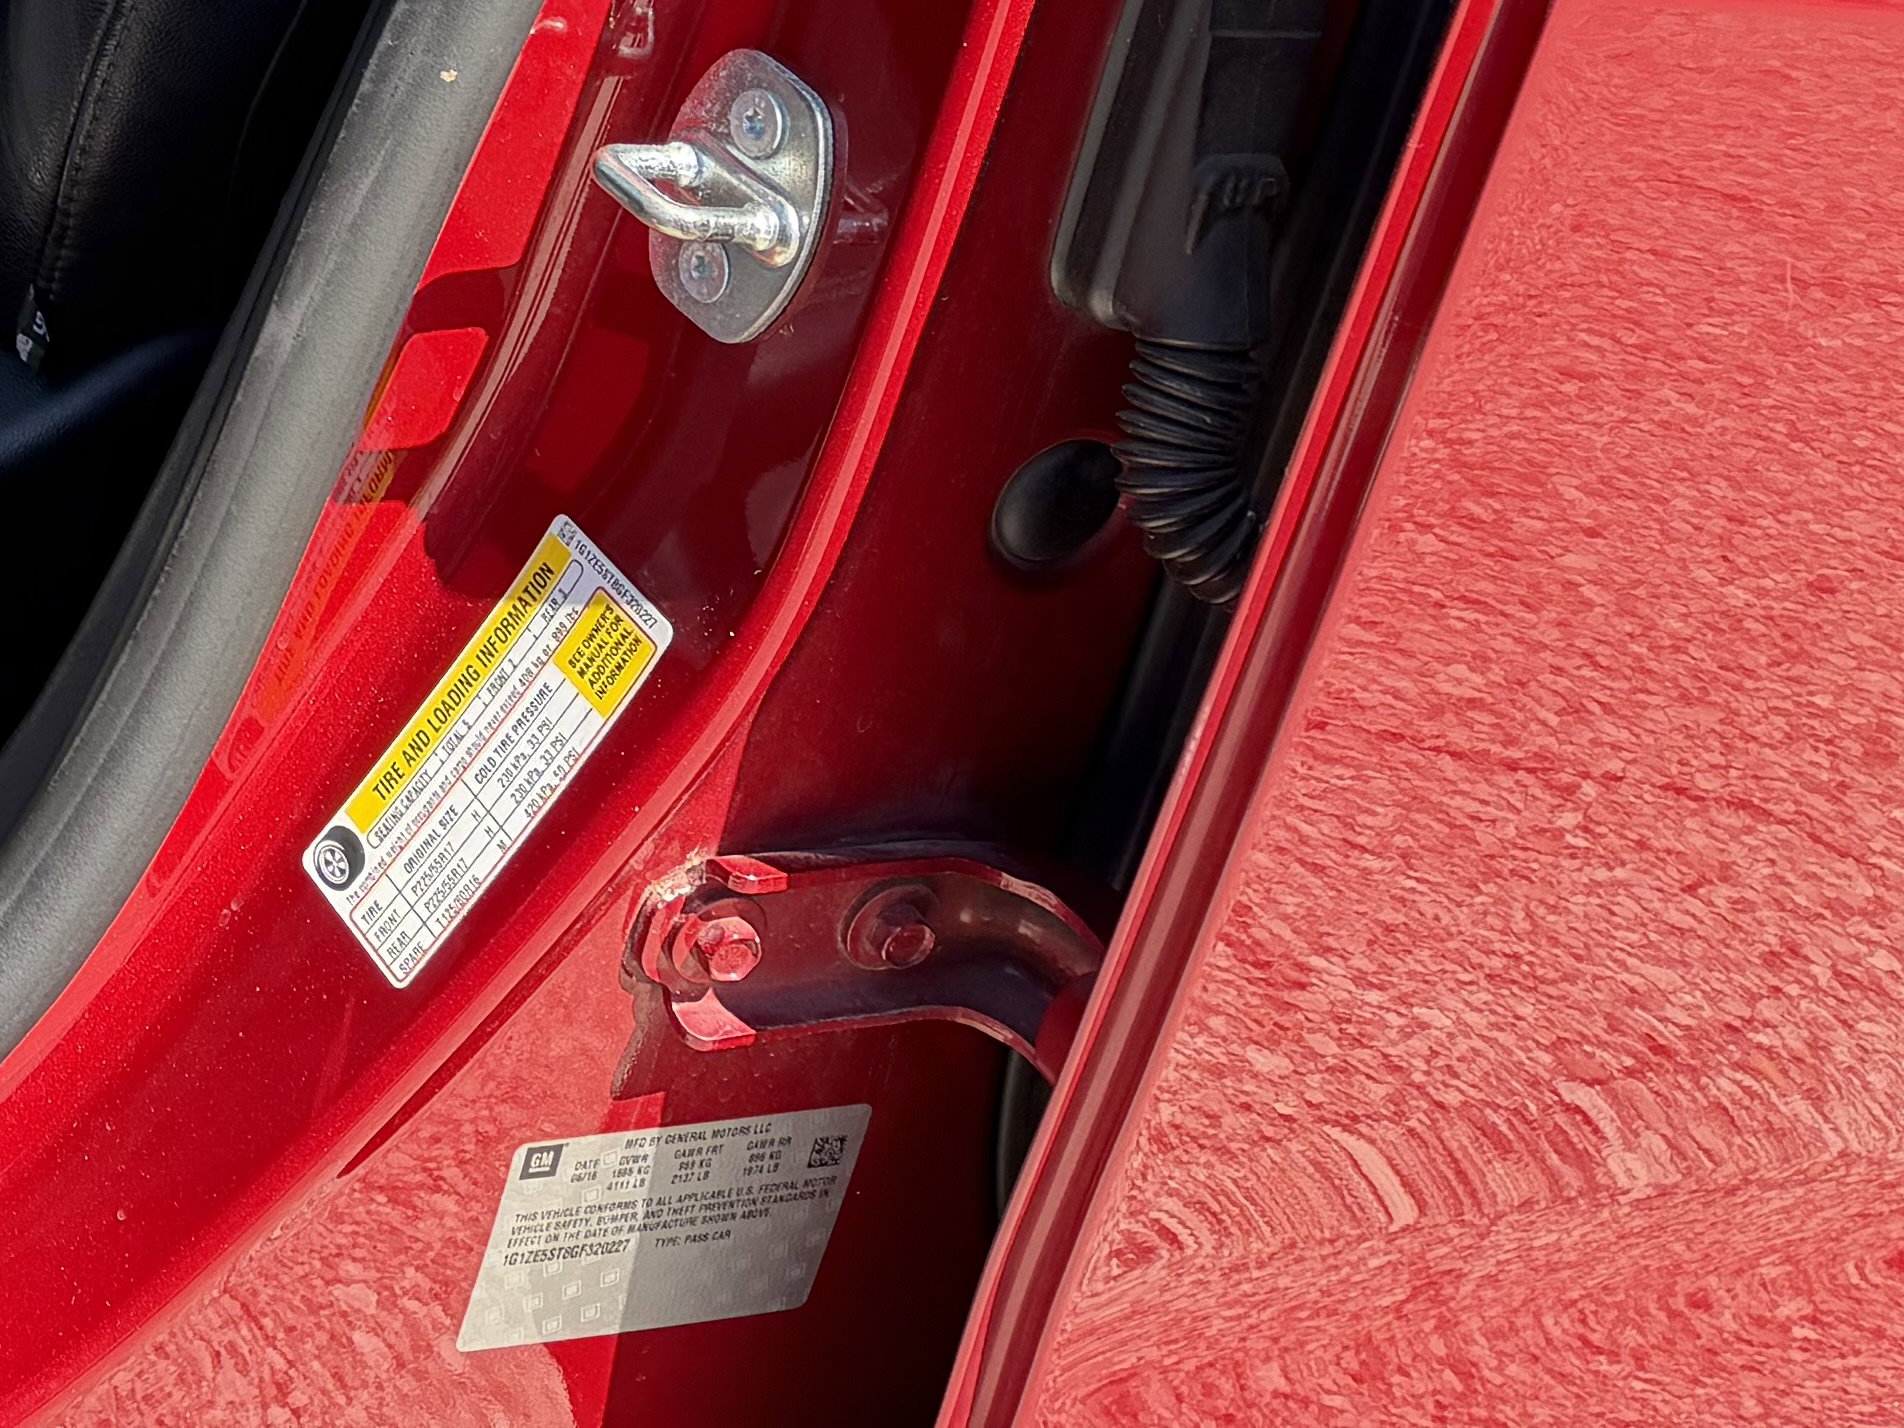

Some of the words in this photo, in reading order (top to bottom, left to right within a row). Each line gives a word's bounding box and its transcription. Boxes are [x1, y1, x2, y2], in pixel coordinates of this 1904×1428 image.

[540, 642, 552, 657] or
[566, 645, 586, 670] SEE
[580, 602, 615, 651] OWNER'S
[575, 635, 609, 679] MANUAL
[604, 612, 624, 639] FOR
[585, 621, 635, 690] ADDITIONAL
[593, 634, 643, 701] INFORMATION
[371, 760, 406, 804] TIRE
[399, 726, 432, 768] AND
[425, 661, 482, 734] LOADING
[474, 560, 555, 669] INFORMATION
[398, 767, 434, 811] CAPACITY
[440, 726, 464, 757] TOTAL
[485, 666, 510, 698] FRONT
[473, 754, 498, 786] COLD
[492, 730, 515, 760] TIRE
[510, 680, 553, 737] PRESSURE
[496, 765, 515, 789] 230
[525, 732, 540, 750] 33
[535, 715, 553, 737] PSI
[509, 781, 528, 805] 230
[538, 747, 554, 767] 33
[549, 730, 567, 753] PSI
[401, 825, 441, 876] ORIGINAL
[437, 802, 459, 831] SIZE
[360, 897, 383, 927] TIRE
[373, 907, 402, 944] FRONT
[385, 927, 411, 961] REAR
[663, 1129, 710, 1145] GENERAL
[709, 1123, 752, 1139] MOTORS
[751, 1121, 773, 1134] LLC
[528, 1150, 555, 1169] GM
[573, 1157, 601, 1171] DATE
[509, 1221, 553, 1236] VEHICLE
[641, 1206, 665, 1220] AND
[513, 1211, 539, 1224] THIS
[538, 1205, 583, 1221] VEHICLE
[639, 1196, 654, 1209] TO
[654, 1194, 675, 1207] ALL
[505, 1233, 543, 1249] EFFECT
[543, 1231, 561, 1244] ON
[562, 1229, 582, 1242] THE
[582, 1225, 609, 1240] DATE
[609, 1223, 624, 1236] OF
[682, 1230, 711, 1245] PASS
[710, 1227, 733, 1241] CAR
